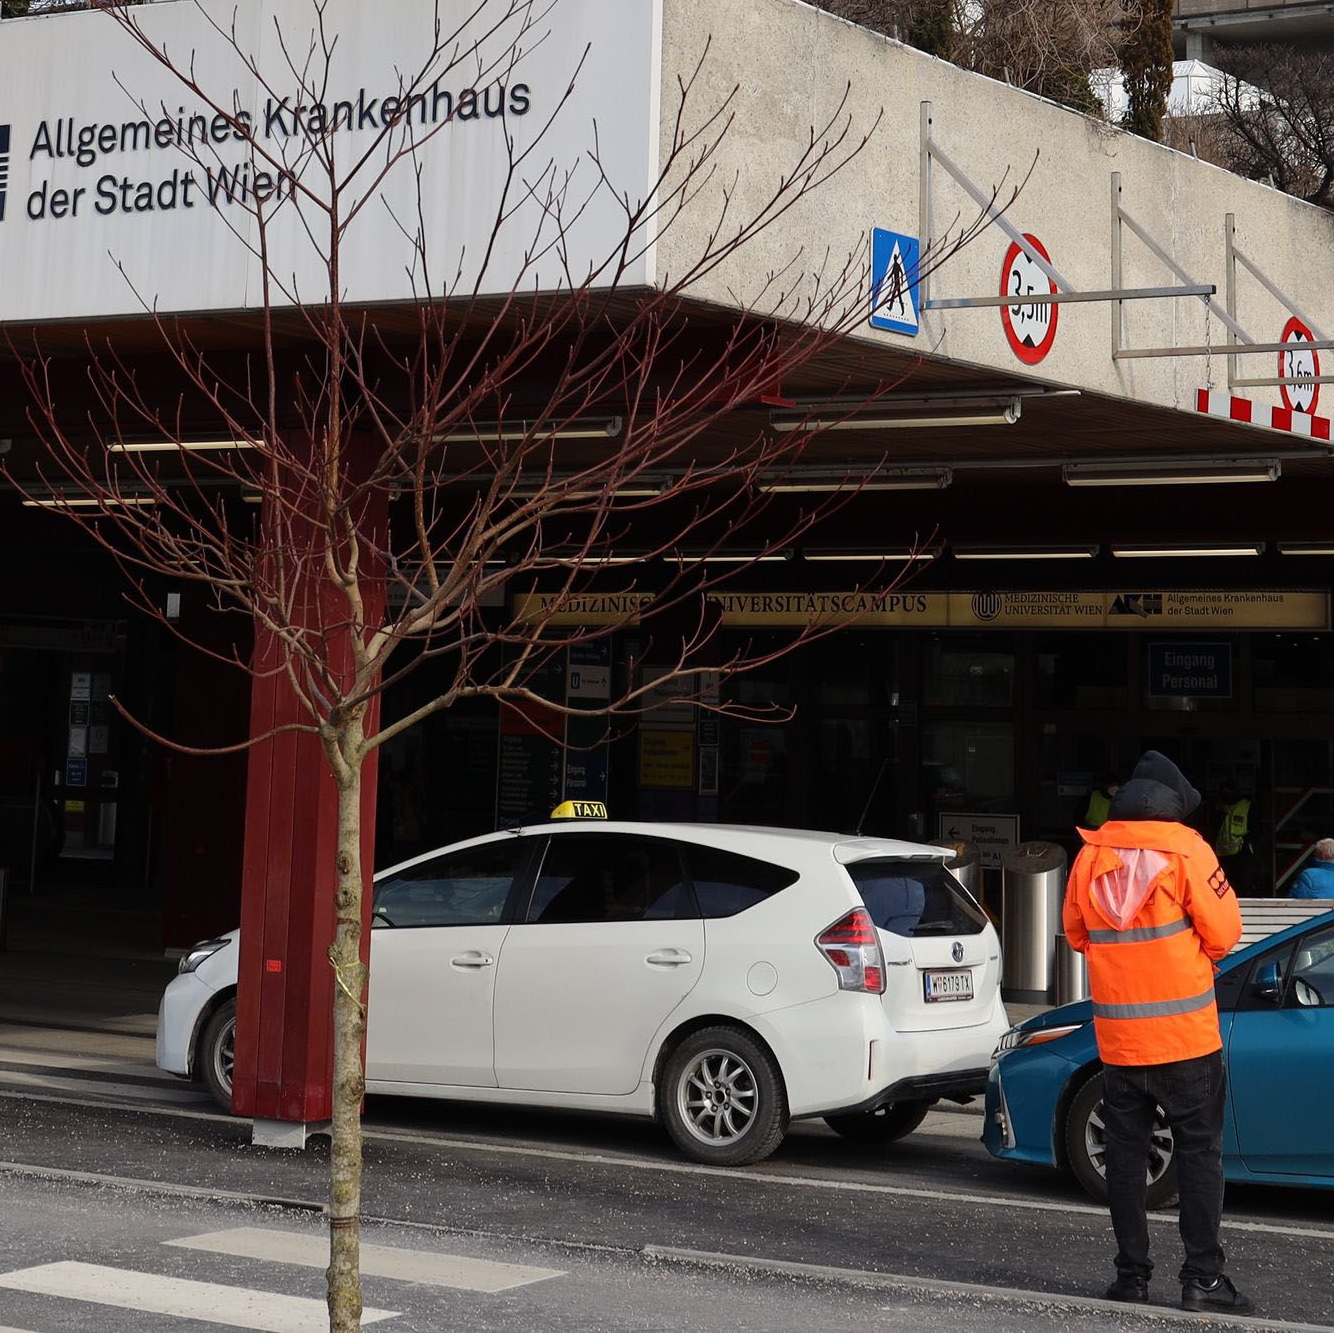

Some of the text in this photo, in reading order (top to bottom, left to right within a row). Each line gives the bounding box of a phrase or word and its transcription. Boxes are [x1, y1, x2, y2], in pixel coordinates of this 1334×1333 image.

[29, 80, 531, 168] Allgemeines Krankenhaus
[26, 161, 298, 221] der Stadt Wien
[709, 589, 928, 614] NIVERSITÄTSCAMPUS
[1004, 593, 1079, 604] MEDIZINISCHE
[1167, 593, 1284, 605] Allgemeines Krankenhaus
[1004, 604, 1103, 615] UNIVERSITÄT WIEN
[1167, 605, 1234, 615] der Stadt Wien
[1164, 650, 1216, 671] Eingang
[1162, 672, 1219, 690] Personal
[574, 803, 606, 817] TAXI
